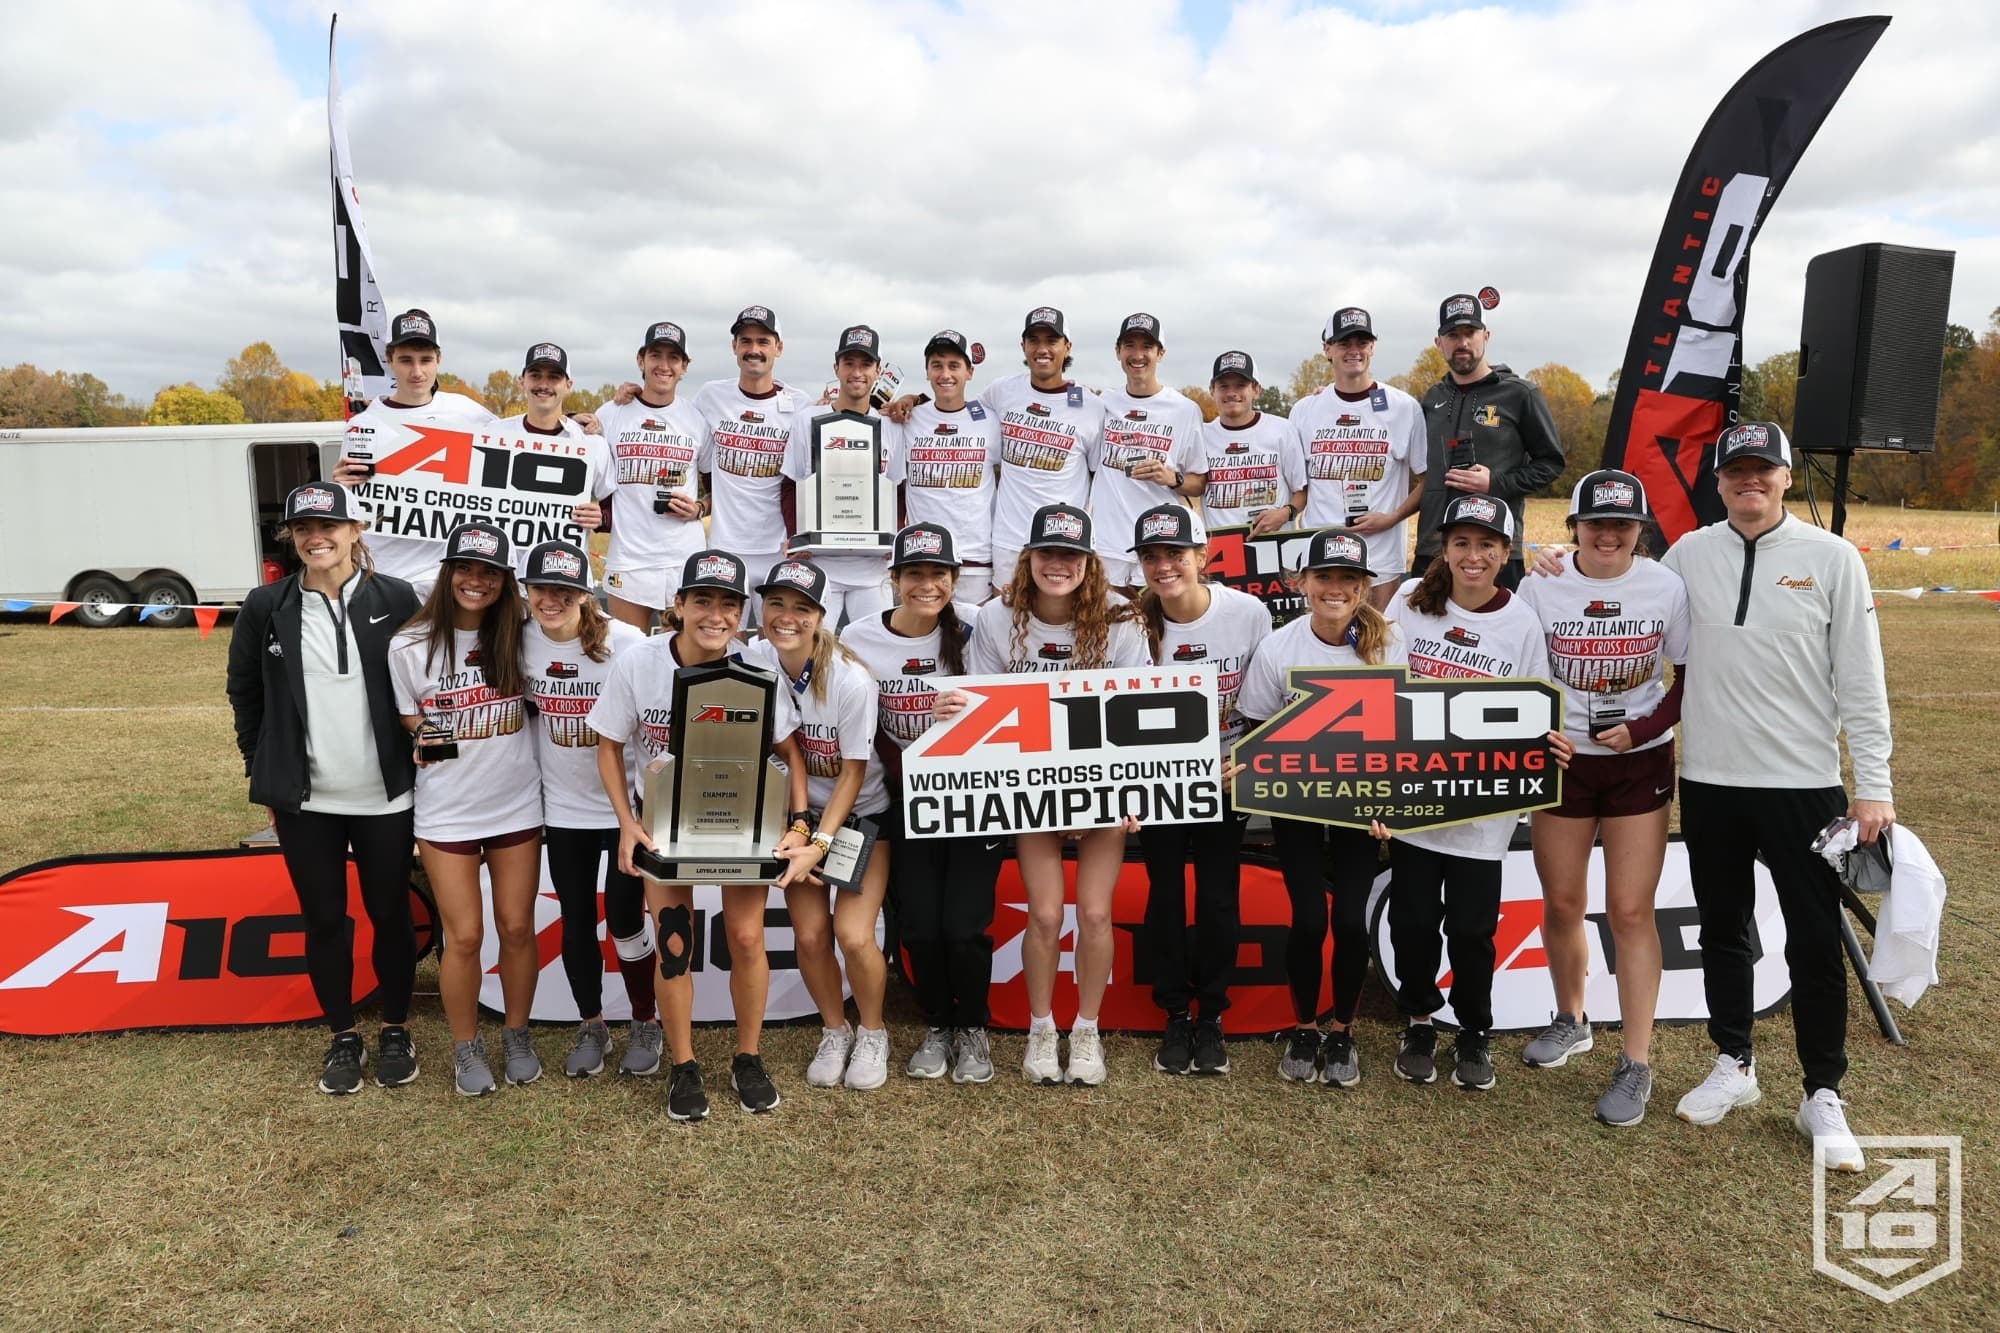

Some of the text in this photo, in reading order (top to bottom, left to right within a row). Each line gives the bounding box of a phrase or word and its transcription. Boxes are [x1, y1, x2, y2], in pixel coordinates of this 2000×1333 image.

[1643, 176, 1721, 377] TLANTIC
[346, 425, 375, 434] A10
[719, 420, 738, 432] 2022
[740, 424, 778, 439] ATLANTIC
[1004, 411, 1076, 436] 2022 ATLANTIC 10
[1162, 424, 1173, 436] 10
[620, 432, 693, 448] 2022 ATLANTIC 10
[1017, 428, 1040, 442] CROSS
[1042, 433, 1075, 450] COUNTRY
[1315, 428, 1387, 440] 2022 ATLANTIC 10
[1729, 432, 1767, 447] CHAMPIONS
[481, 434, 587, 457] TLANTIC
[734, 436, 757, 449] CROSS
[823, 436, 870, 450] A10
[913, 437, 985, 448] 2022 ATLANTIC 10
[1311, 442, 1388, 453] MEN'S CROSS COUNTRY
[374, 423, 588, 497] A10
[617, 445, 693, 461] MEN'S CROSS COUNTRY
[911, 450, 985, 461] MEN'S CROSS COUNTRY
[1227, 454, 1265, 467] ATLANTIC
[1268, 453, 1278, 465] 10
[910, 463, 983, 488] CHAMPIONS
[1223, 468, 1248, 481] CROSS
[1311, 455, 1386, 481] CHAMPIONS
[296, 493, 333, 507] CHAMPIONS
[351, 482, 577, 520] MEN'S CROSS COUNTR
[1595, 488, 1633, 501] CHAMPIONS
[1458, 504, 1496, 518] CHAMPIONS
[1045, 519, 1082, 534] CHAMPIONS
[1143, 519, 1178, 534] CHAMPIONS
[460, 536, 498, 550] CHAMPIONS
[905, 537, 942, 551] CHAMPIONS
[1326, 543, 1360, 557] CHAMPIONS
[544, 557, 580, 572] CHAMPIONS
[698, 563, 736, 577] CHAMPIONS
[1552, 619, 1664, 637] 2022 ATLANTIC 10
[1552, 635, 1661, 655] WOMEN'S CROSS COUNTRY
[1412, 638, 1512, 677] 2022 ATLANTIC 10
[438, 672, 468, 691] 2022
[550, 681, 601, 696] ATLANTIC
[1059, 675, 1203, 694] TLANTIC
[555, 699, 580, 713] CROSS
[881, 696, 911, 710] OMEN'S
[1263, 678, 1552, 742] A10
[643, 708, 672, 725] 2022
[691, 703, 760, 724] A10
[918, 682, 1209, 757] A10
[826, 726, 837, 739] 10
[1252, 750, 1546, 774] CELEBRATING
[909, 758, 1215, 792] WOMEN'S CROSS COUNTRY
[1253, 777, 1545, 799] 50 YEARS OF TITLE IX
[908, 781, 1219, 835] CHAMPIONS
[1353, 804, 1445, 817] 1972-2022
